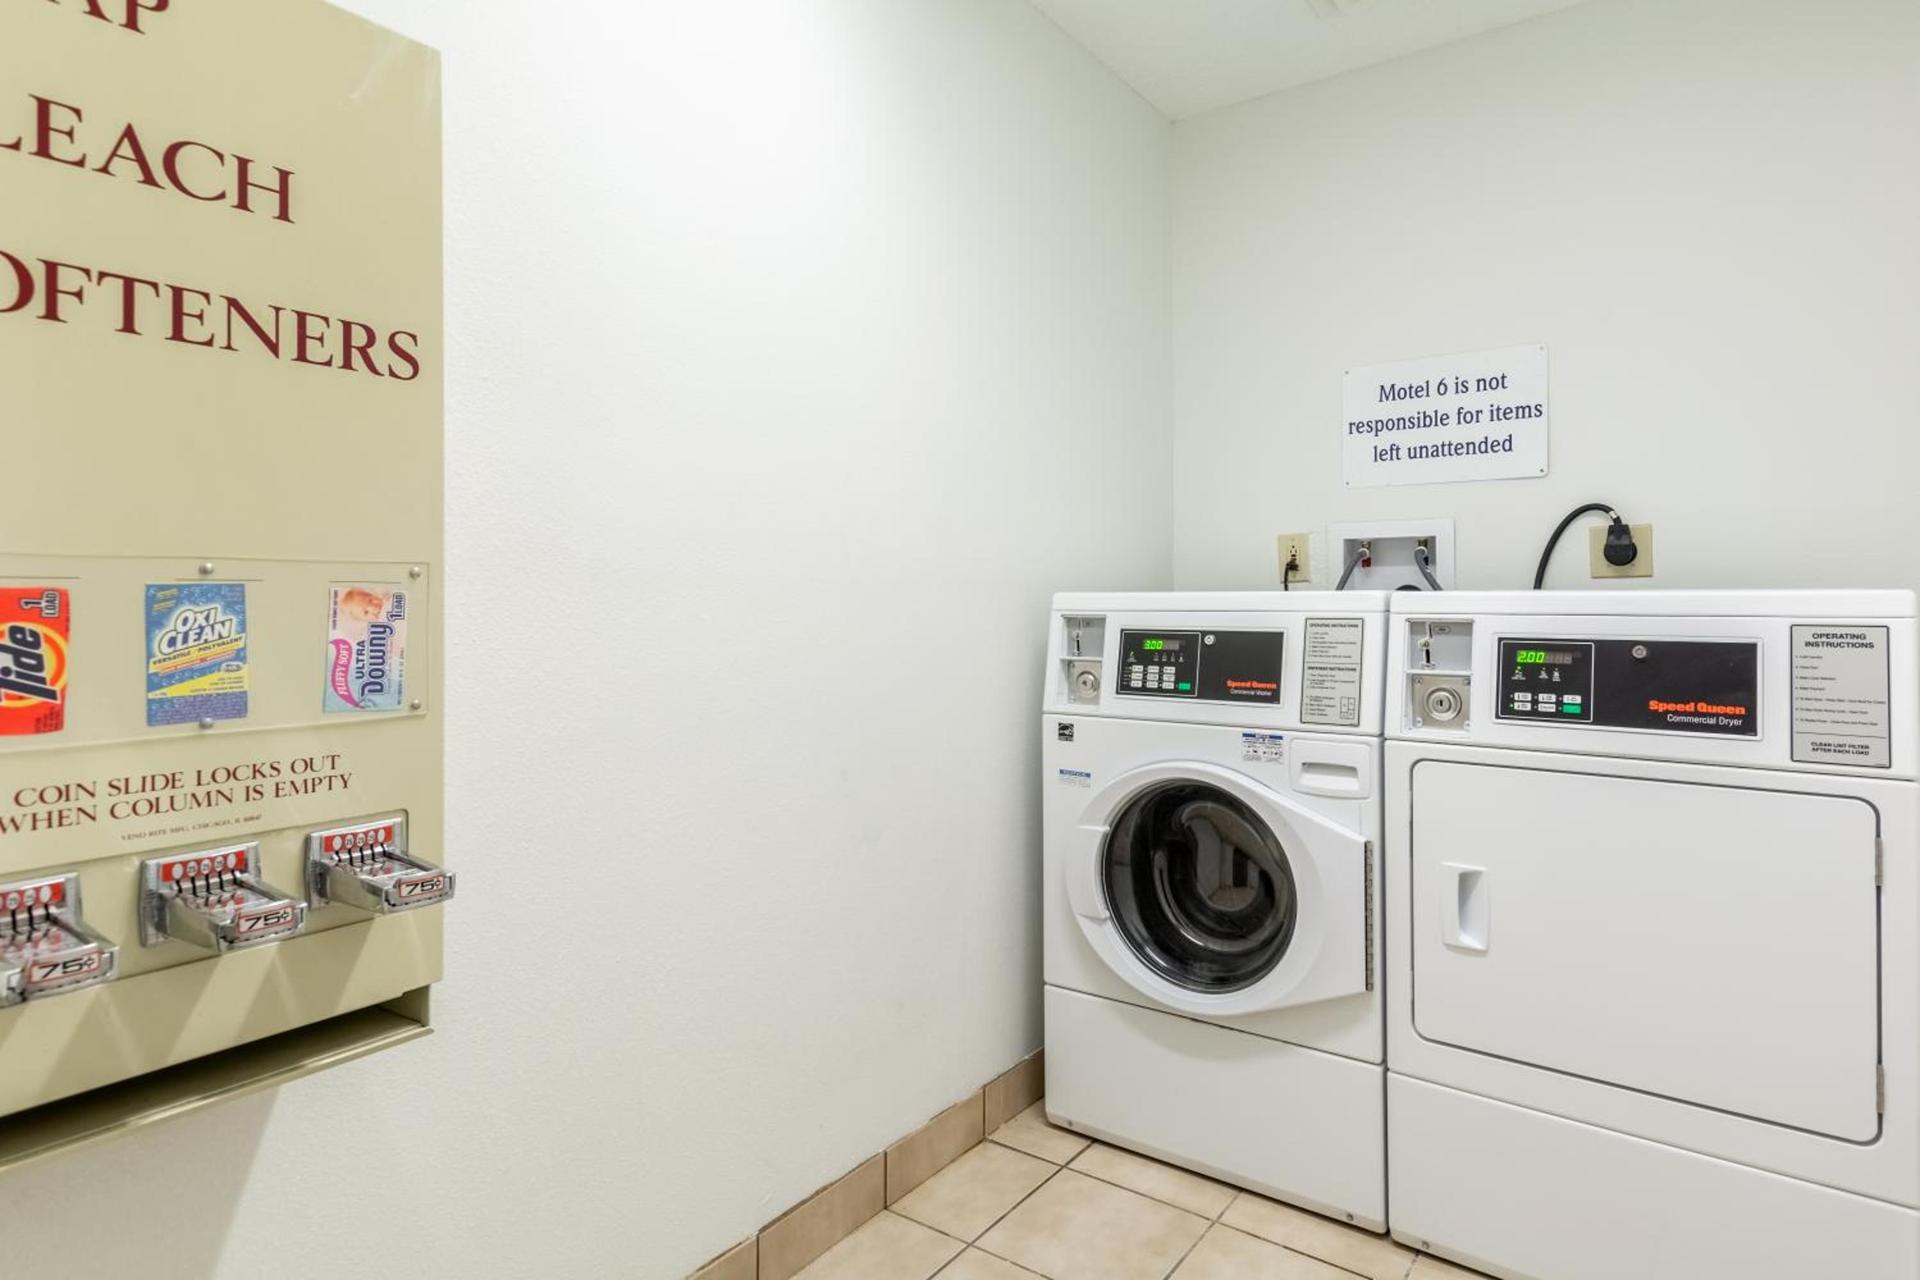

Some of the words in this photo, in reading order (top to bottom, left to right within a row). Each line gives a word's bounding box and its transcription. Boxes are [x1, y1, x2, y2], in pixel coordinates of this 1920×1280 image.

[0, 93, 296, 224] EACH
[1378, 380, 1431, 403] Motel
[1437, 377, 1448, 396] 6
[1454, 376, 1469, 394] is
[1475, 372, 1508, 392] not
[1348, 409, 1450, 437] responsible
[1456, 406, 1483, 425] for
[1488, 402, 1543, 422] items
[1373, 443, 1402, 463] left
[1407, 433, 1514, 460] unattended
[44, 591, 57, 616] LOAD
[394, 594, 404, 614] LOAD
[175, 607, 218, 633] OXI
[158, 618, 233, 655] CLEAN
[1805, 641, 1875, 649] INSTRUCTIONS
[339, 643, 350, 665] SOFT
[355, 640, 366, 679] ULTRA
[360, 624, 393, 697] Downy
[1227, 680, 1250, 689] Speed
[1251, 680, 1277, 689] Queen
[1648, 700, 1695, 712] Speed
[1697, 702, 1746, 715] Queen
[1667, 714, 1716, 724] Commercial
[1719, 717, 1742, 727] Dryer
[14, 781, 97, 808] COIN
[108, 771, 184, 797] SLIDE
[196, 761, 281, 787] LOCKS
[290, 754, 341, 775] OUT
[0, 804, 97, 835] WHEN
[110, 788, 234, 820] COLUMN
[245, 784, 264, 802] IS
[274, 772, 352, 798] EMPTY
[244, 909, 290, 931] 75¢
[38, 957, 95, 979] 75¢
